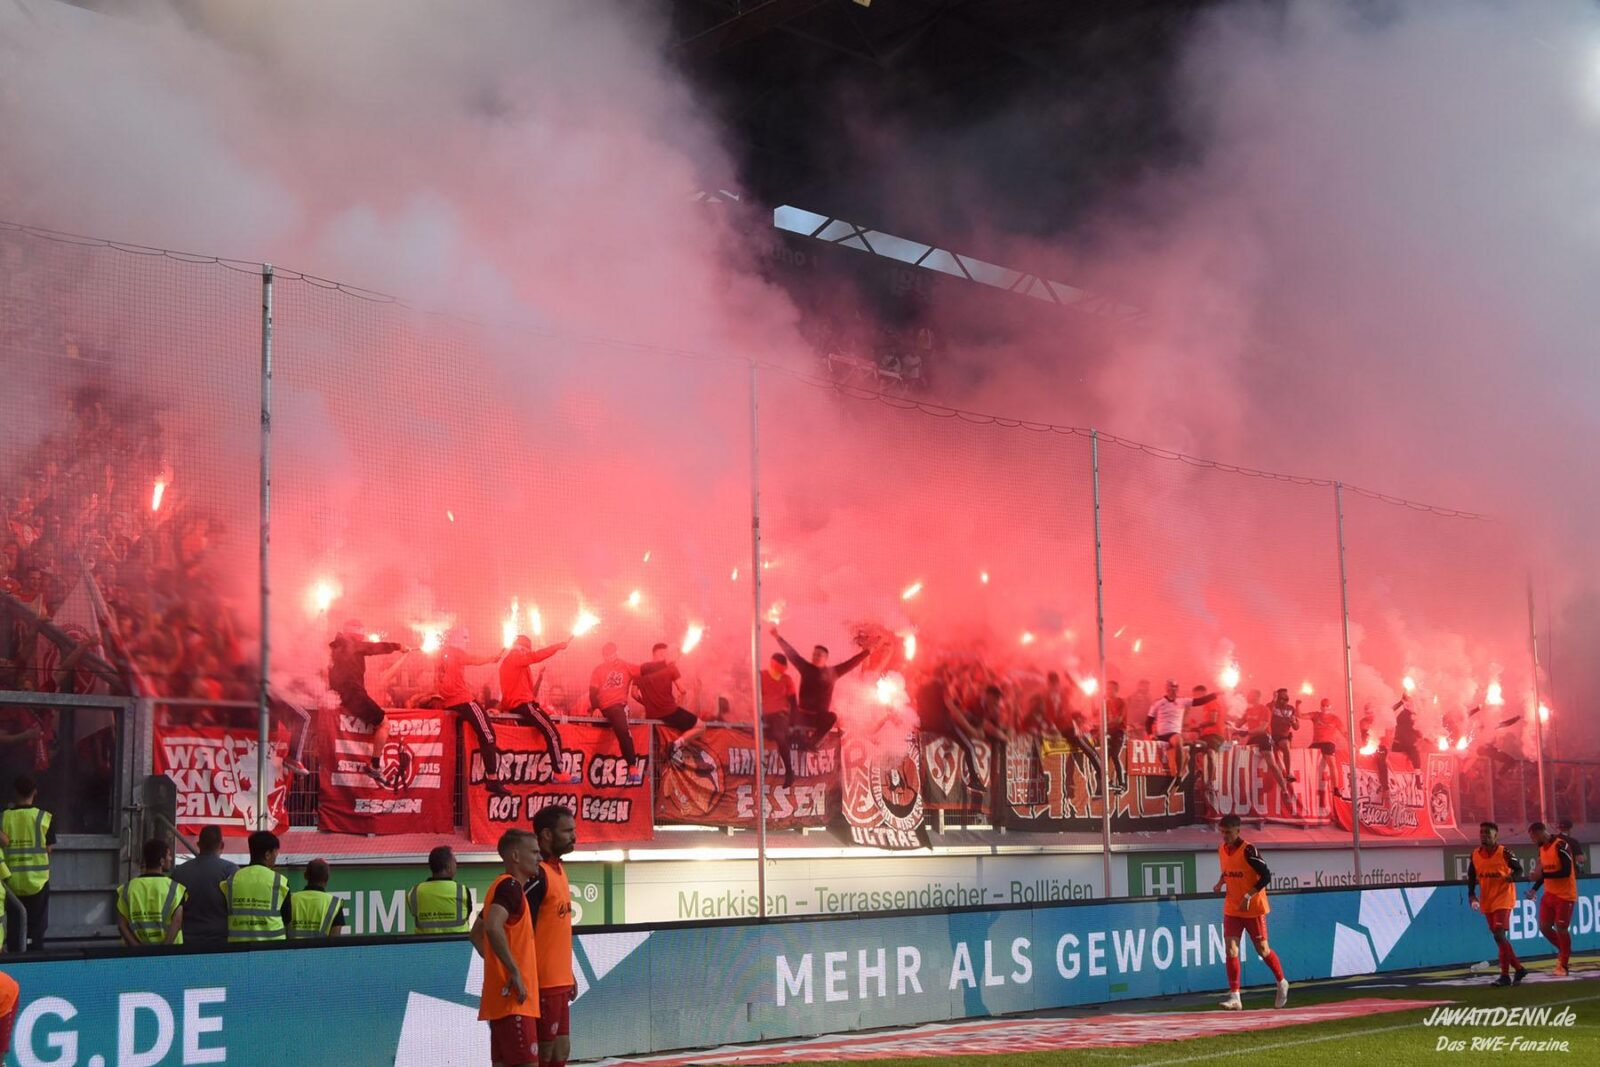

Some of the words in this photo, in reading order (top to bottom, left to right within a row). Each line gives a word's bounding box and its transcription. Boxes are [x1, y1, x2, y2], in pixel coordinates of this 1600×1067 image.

[340, 713, 441, 736] KAGORIE
[471, 752, 583, 784] NRTHSDE
[354, 799, 422, 814] ESSEN
[489, 796, 521, 820] ROT
[582, 798, 630, 822] ESSEN
[851, 827, 920, 847] ULTRAS
[1269, 872, 1298, 890] üren
[1315, 868, 1422, 888] Kunstsofffenster
[329, 889, 406, 935] EIM
[678, 889, 787, 918] Markisen
[814, 882, 987, 913] Terrassendächer
[1010, 878, 1093, 904] Rollläden
[1508, 894, 1600, 940] EB.DE
[775, 945, 923, 1008] MEHR
[948, 936, 1033, 990] ALS
[14, 986, 227, 1067] G.DE
